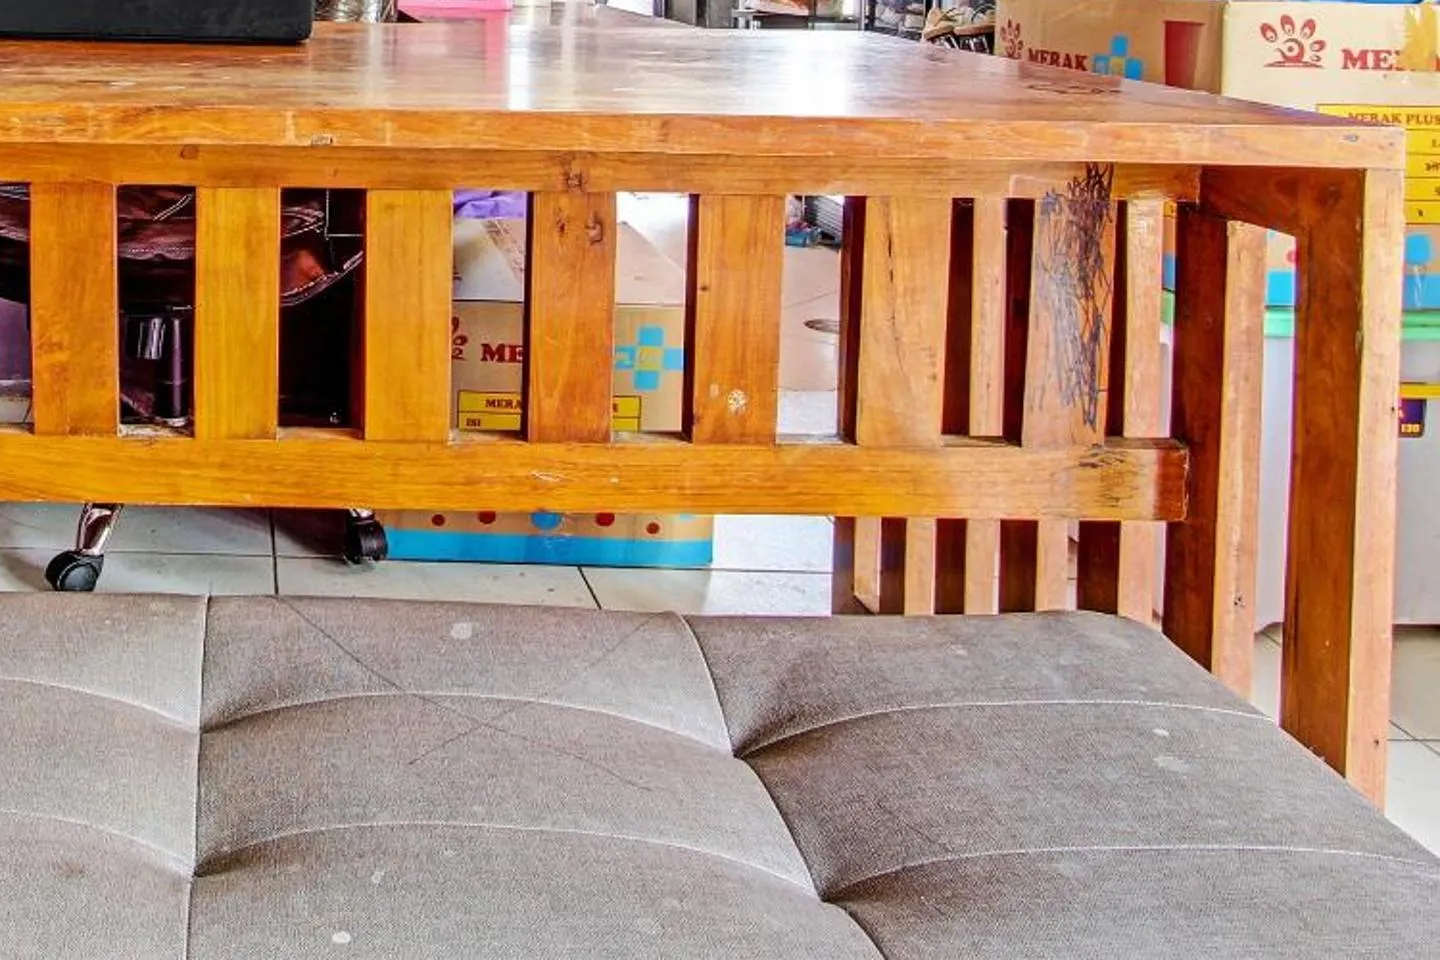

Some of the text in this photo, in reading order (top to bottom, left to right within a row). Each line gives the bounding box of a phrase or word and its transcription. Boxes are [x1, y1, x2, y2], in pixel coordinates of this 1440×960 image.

[1028, 48, 1089, 71] MERAK
[485, 398, 523, 409] MERA
[465, 418, 481, 427] ISI
